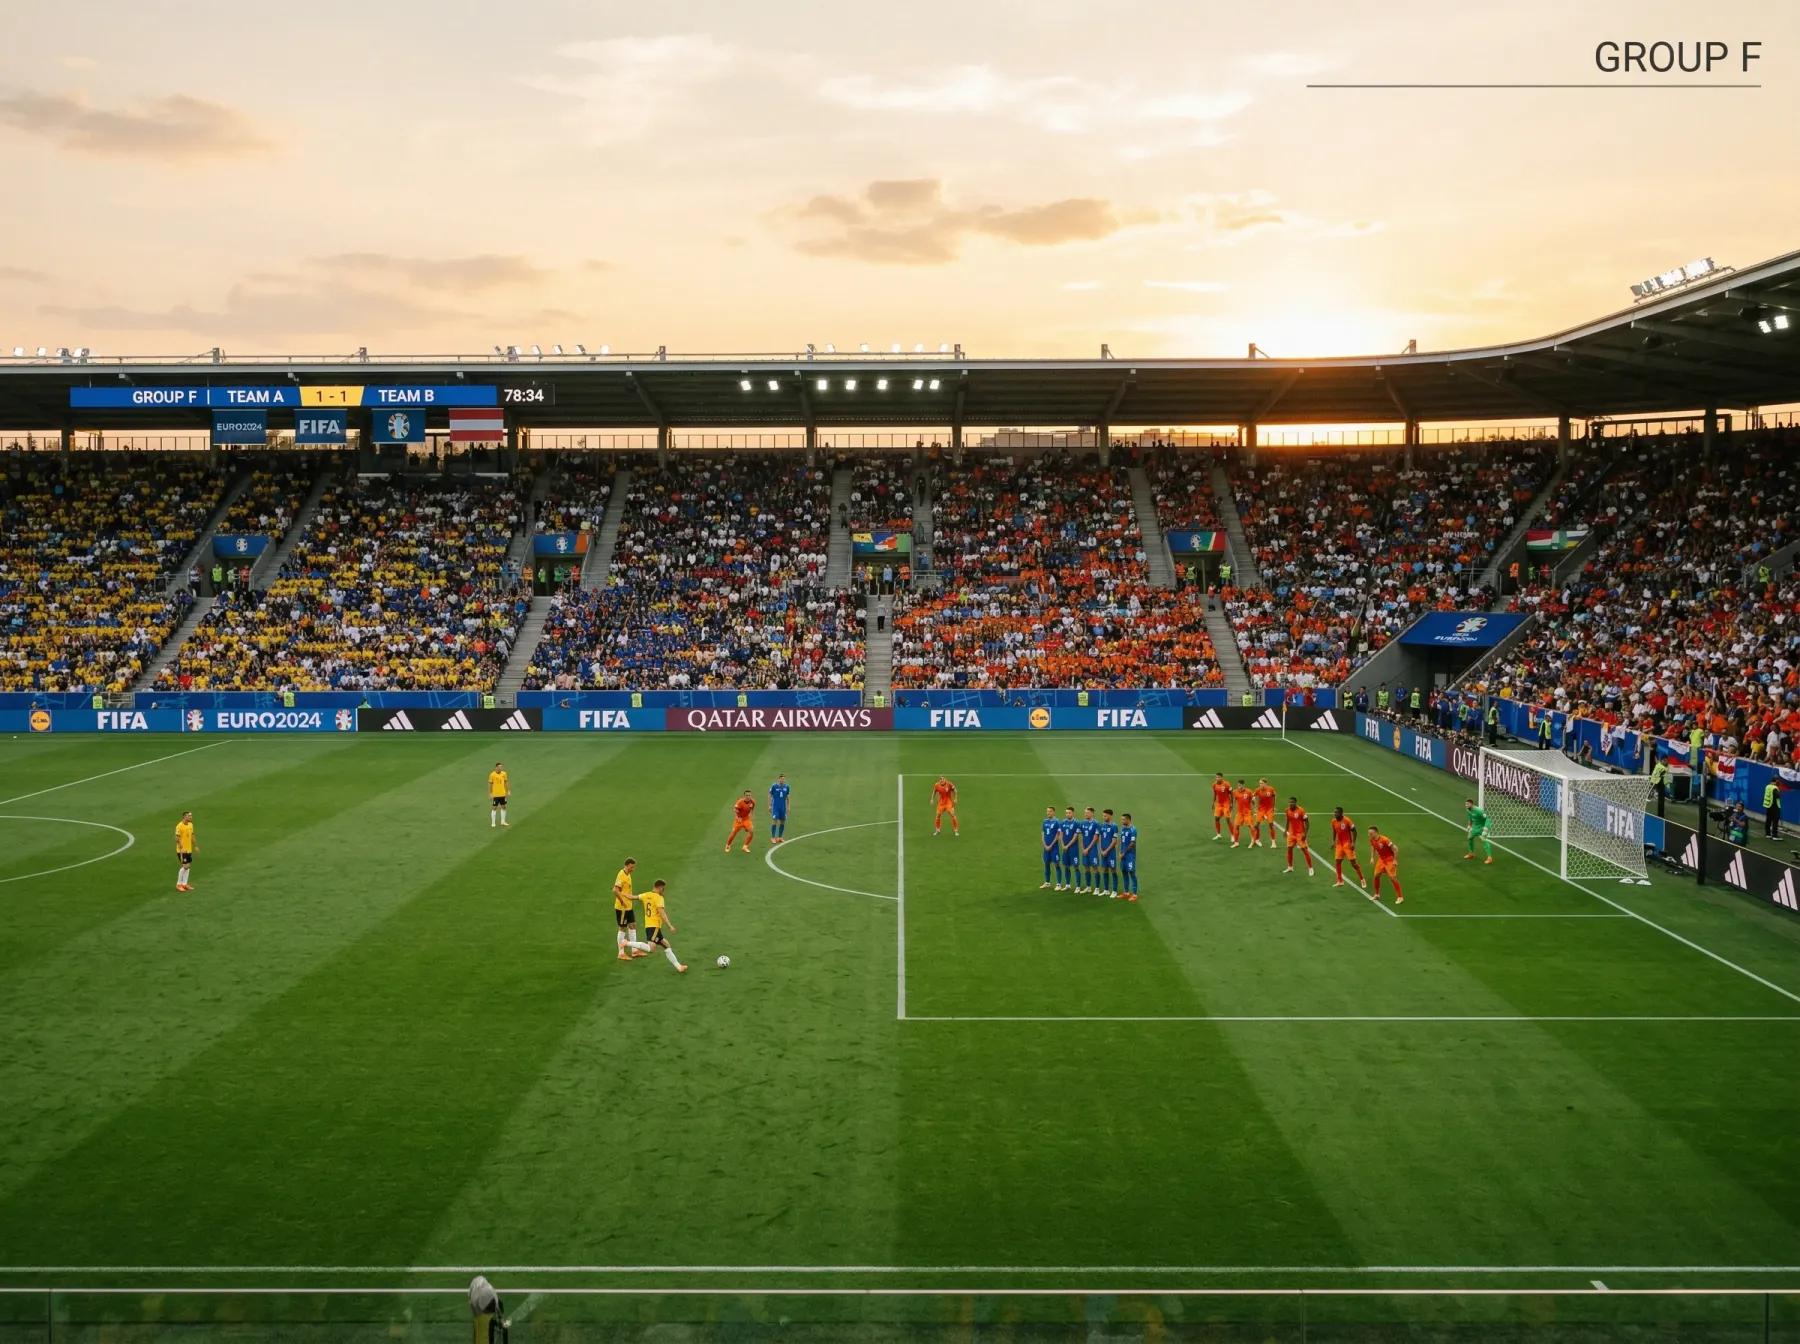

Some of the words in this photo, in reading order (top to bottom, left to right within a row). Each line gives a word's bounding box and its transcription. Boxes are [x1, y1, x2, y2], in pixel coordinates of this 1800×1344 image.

[132, 390, 184, 404] GROUP
[188, 390, 197, 403] F
[227, 390, 269, 403] TEAM
[273, 390, 284, 403] A
[316, 390, 323, 402] 1
[340, 390, 347, 402] 1
[378, 389, 420, 402] TEAM
[424, 389, 435, 402] B
[504, 389, 544, 402] 78:34
[216, 422, 263, 431] EURO2024
[299, 419, 340, 435] FIFA
[97, 711, 149, 730] FIFA
[217, 712, 322, 729] EURO2024
[579, 710, 631, 729] FIFA
[687, 709, 766, 731] QATAR
[771, 709, 872, 728] AIRWAYS
[930, 709, 982, 728] FIFA
[1097, 709, 1148, 727] FIFA
[1365, 718, 1380, 741] FIFA
[1415, 735, 1432, 762] FIFA
[1484, 760, 1531, 799] AIRWAYS
[1606, 804, 1635, 840] FIFA
[646, 902, 652, 918] 6
